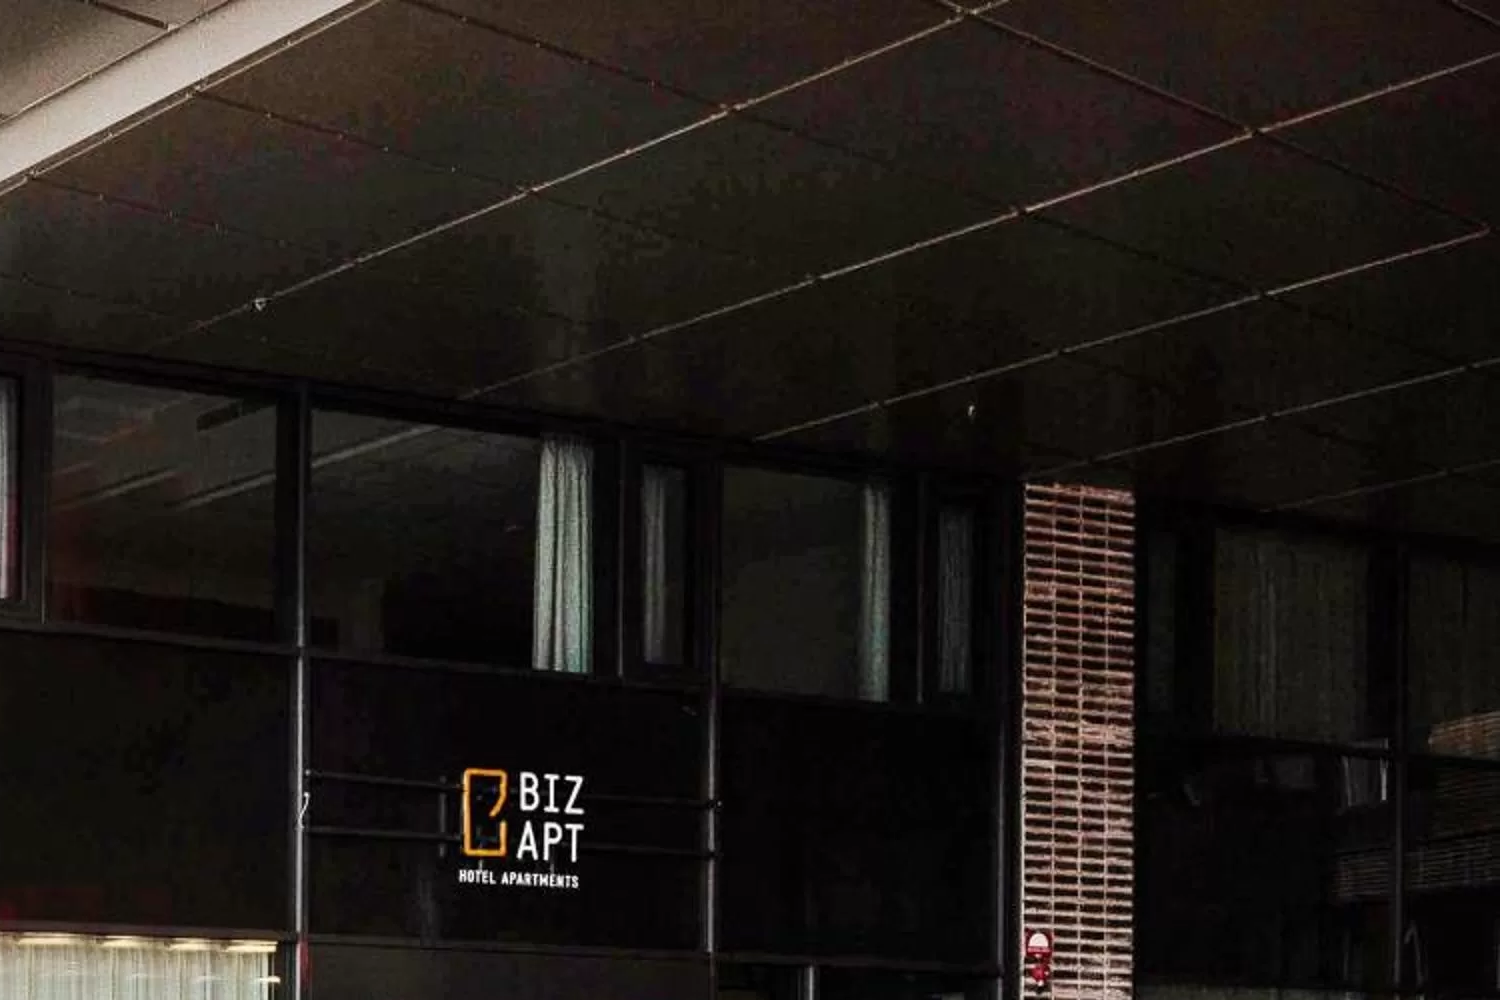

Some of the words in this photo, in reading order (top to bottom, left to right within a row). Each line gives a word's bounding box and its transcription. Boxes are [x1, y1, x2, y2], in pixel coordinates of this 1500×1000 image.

[519, 771, 585, 814] BIZ
[516, 820, 585, 863] APT
[459, 869, 497, 885] HOTEL
[501, 871, 579, 889] APARTMENTS
